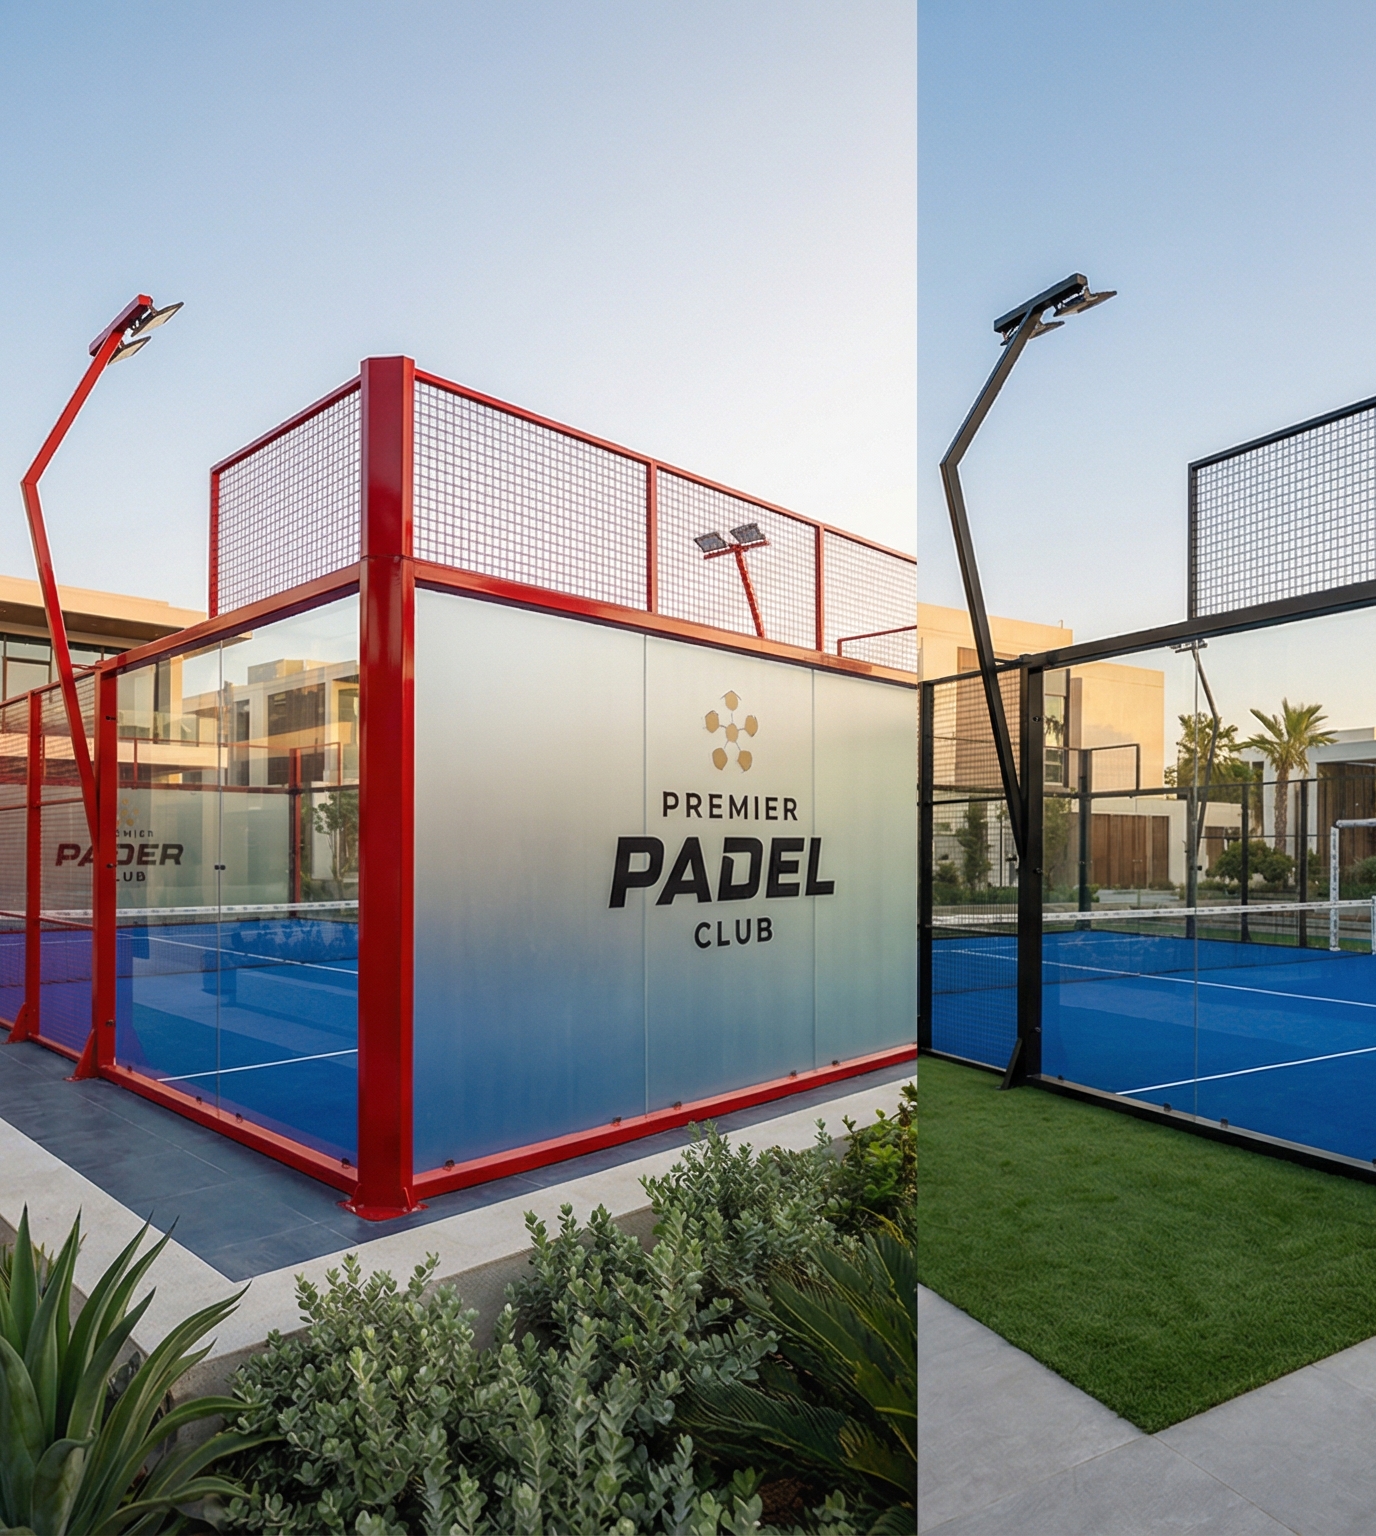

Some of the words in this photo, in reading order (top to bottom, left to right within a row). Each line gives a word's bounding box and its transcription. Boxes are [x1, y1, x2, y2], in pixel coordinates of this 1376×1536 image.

[662, 791, 798, 821] PREMIER
[116, 871, 146, 882] UB
[608, 836, 836, 909] PADEL
[694, 917, 774, 949] CLUB
